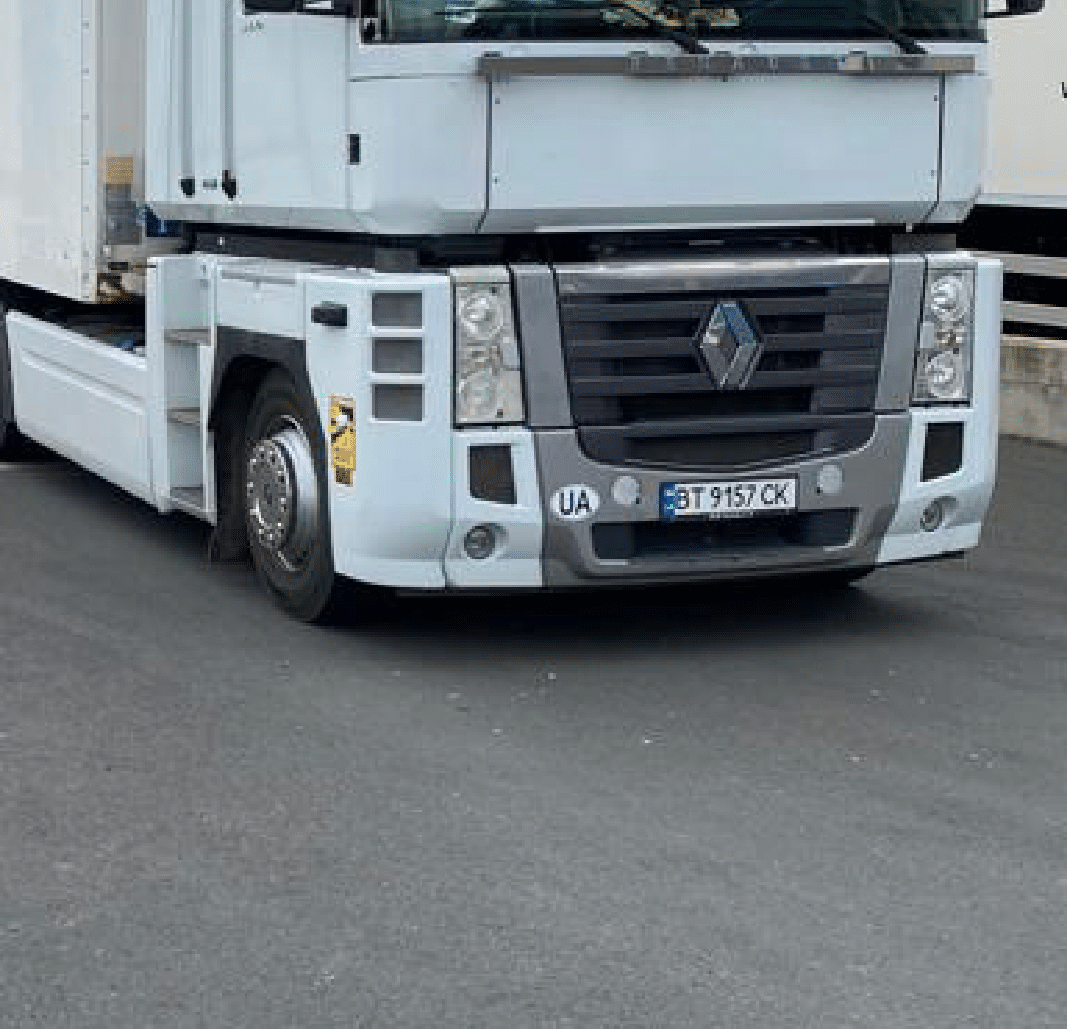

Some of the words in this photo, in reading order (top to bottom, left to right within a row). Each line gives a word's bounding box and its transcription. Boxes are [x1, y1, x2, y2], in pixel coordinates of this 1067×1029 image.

[560, 490, 592, 515] UA
[677, 486, 706, 509] BT
[710, 484, 757, 508] 9157
[760, 482, 791, 505] CK
